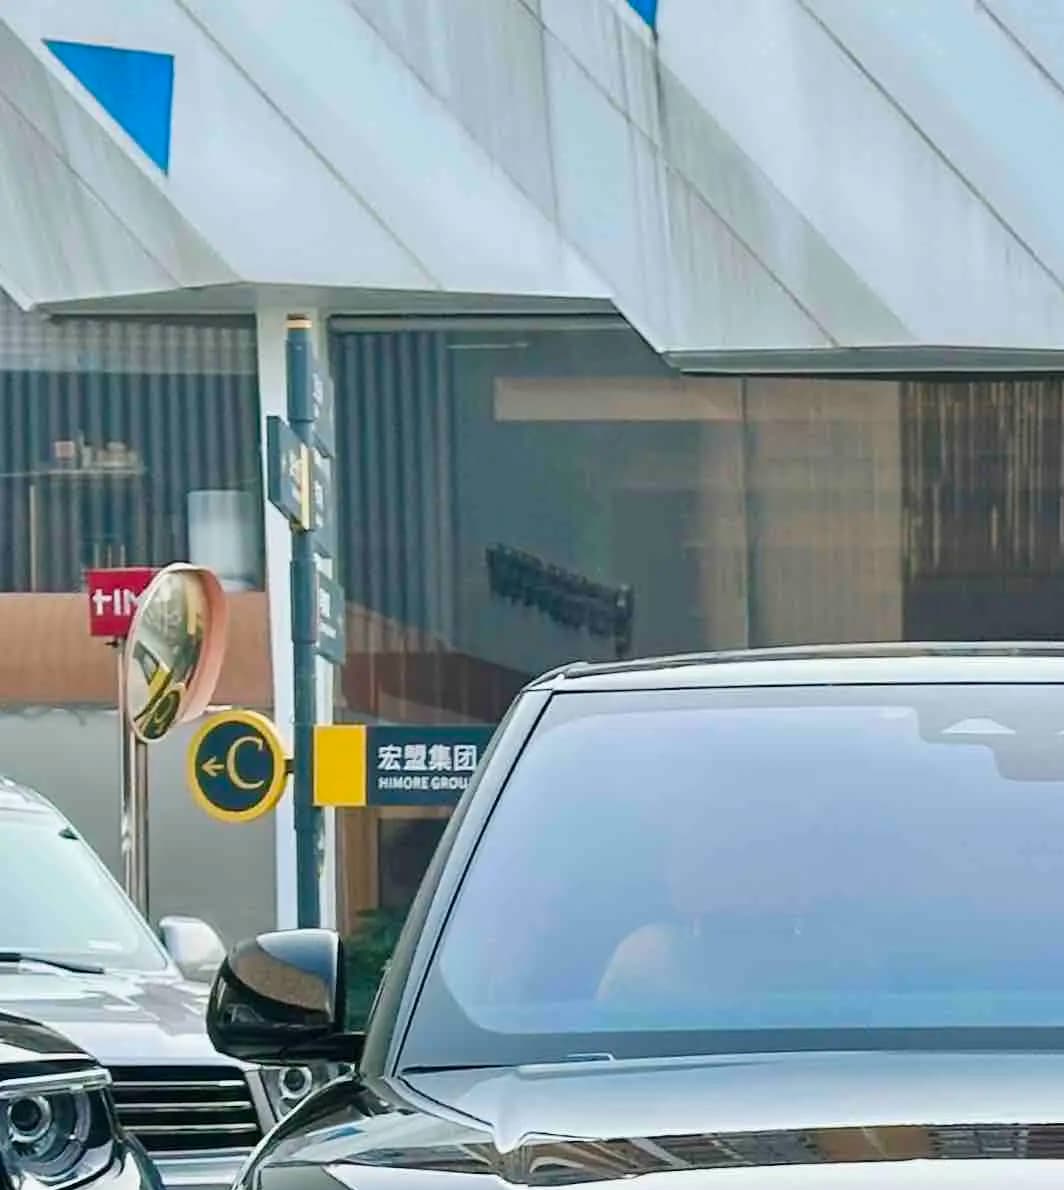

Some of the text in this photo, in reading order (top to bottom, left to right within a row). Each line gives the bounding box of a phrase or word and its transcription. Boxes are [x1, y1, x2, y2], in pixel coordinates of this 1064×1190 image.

[226, 735, 265, 790] C
[377, 743, 477, 771] 宏盟集团
[378, 775, 471, 790] HIMORE GROU
